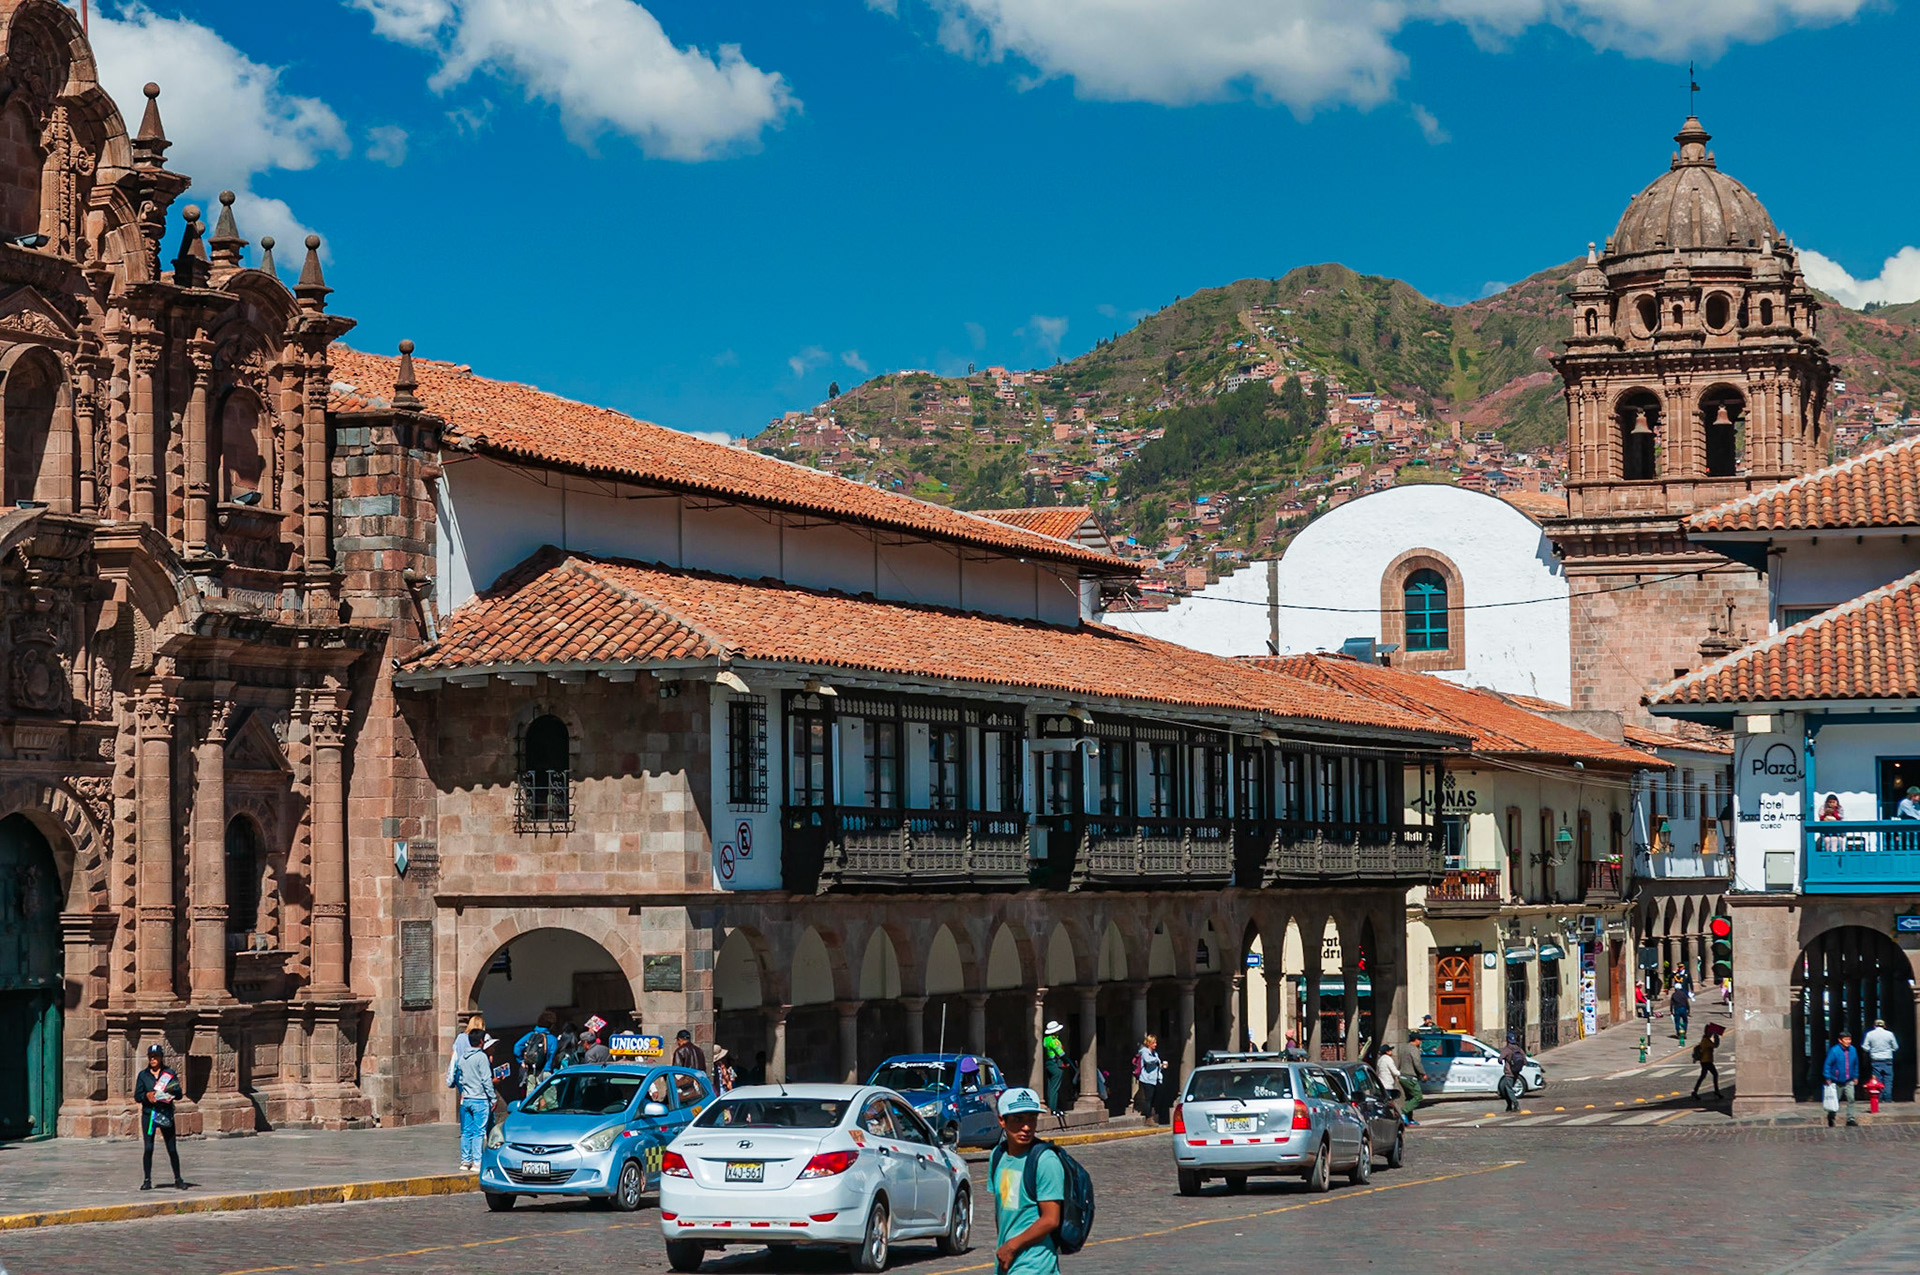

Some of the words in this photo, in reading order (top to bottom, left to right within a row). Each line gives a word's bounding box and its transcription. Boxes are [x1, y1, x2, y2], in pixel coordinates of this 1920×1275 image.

[1753, 752, 1797, 775] Plaza
[1758, 799, 1784, 810] Hotel
[1737, 811, 1760, 821] Plaza
[1763, 811, 1776, 821] de
[611, 1037, 650, 1050] UNICOS
[727, 1167, 761, 1179] X4J-561
